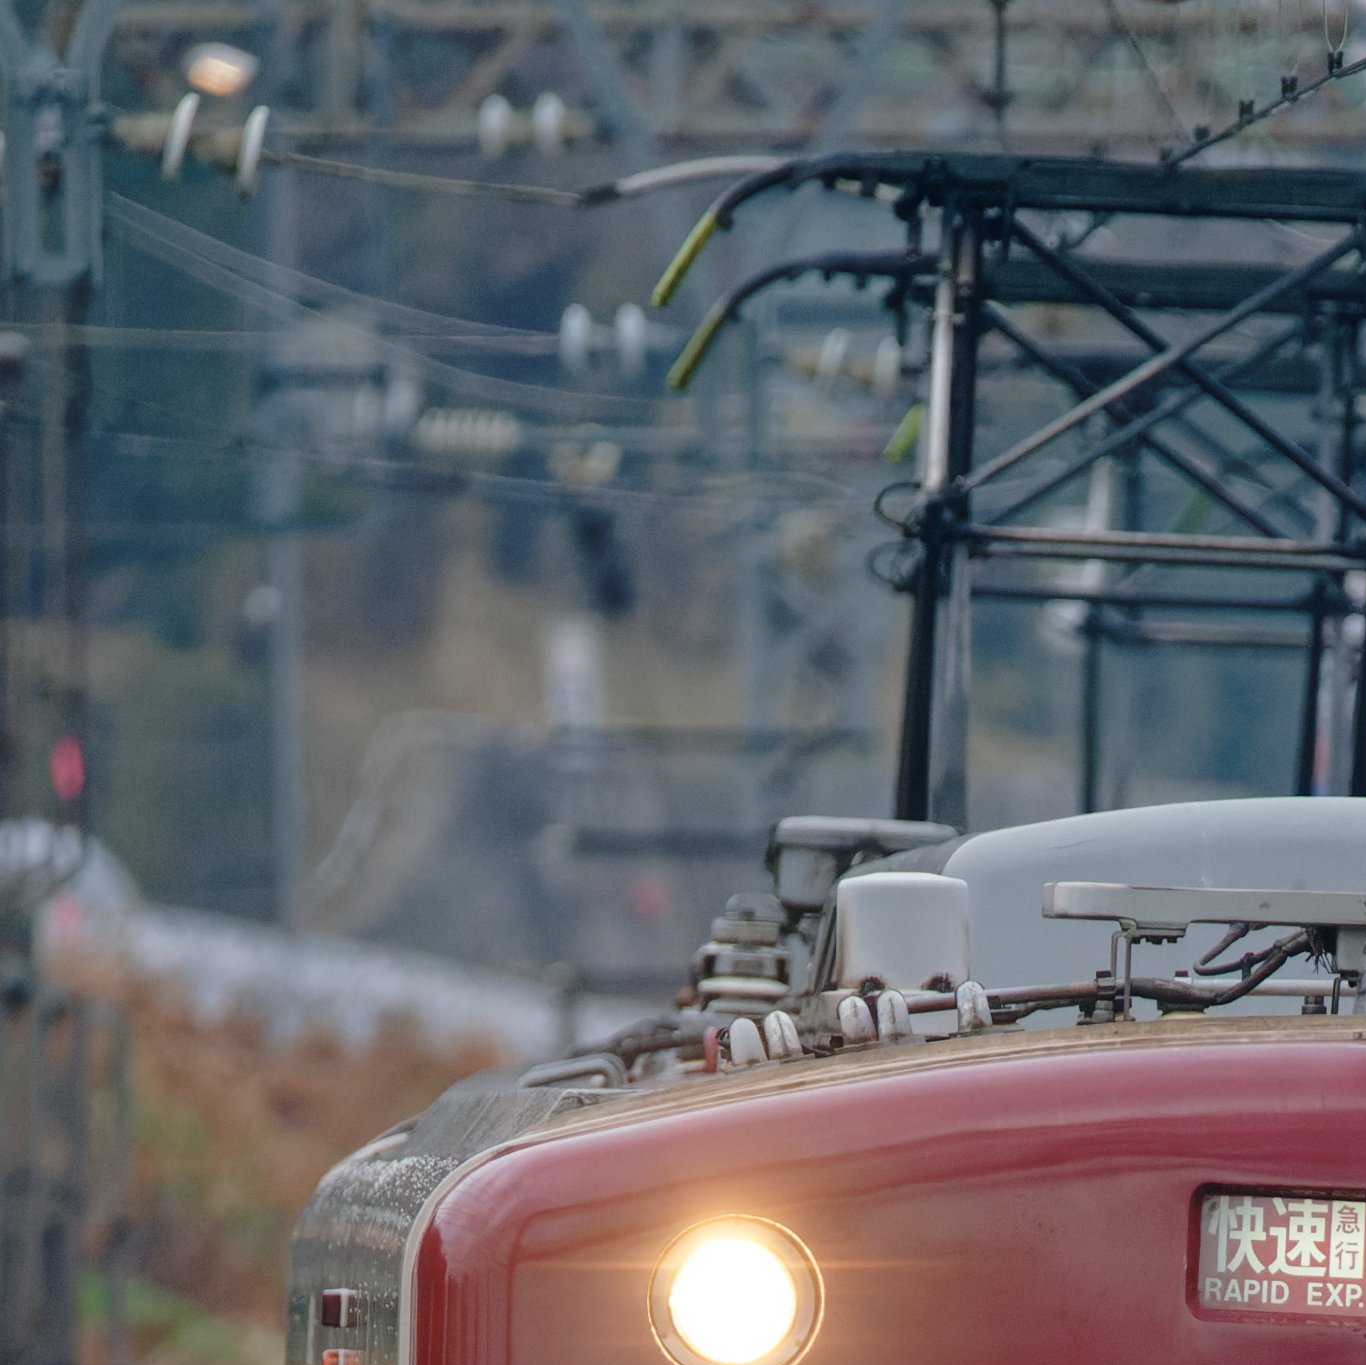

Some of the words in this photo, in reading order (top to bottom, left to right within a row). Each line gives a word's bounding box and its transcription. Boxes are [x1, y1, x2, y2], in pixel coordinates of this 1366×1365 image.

[1207, 1195, 1329, 1277] 快速
[1334, 1204, 1361, 1270] 急行
[1204, 1277, 1290, 1305] RAPID
[1306, 1281, 1365, 1308] EXP.
